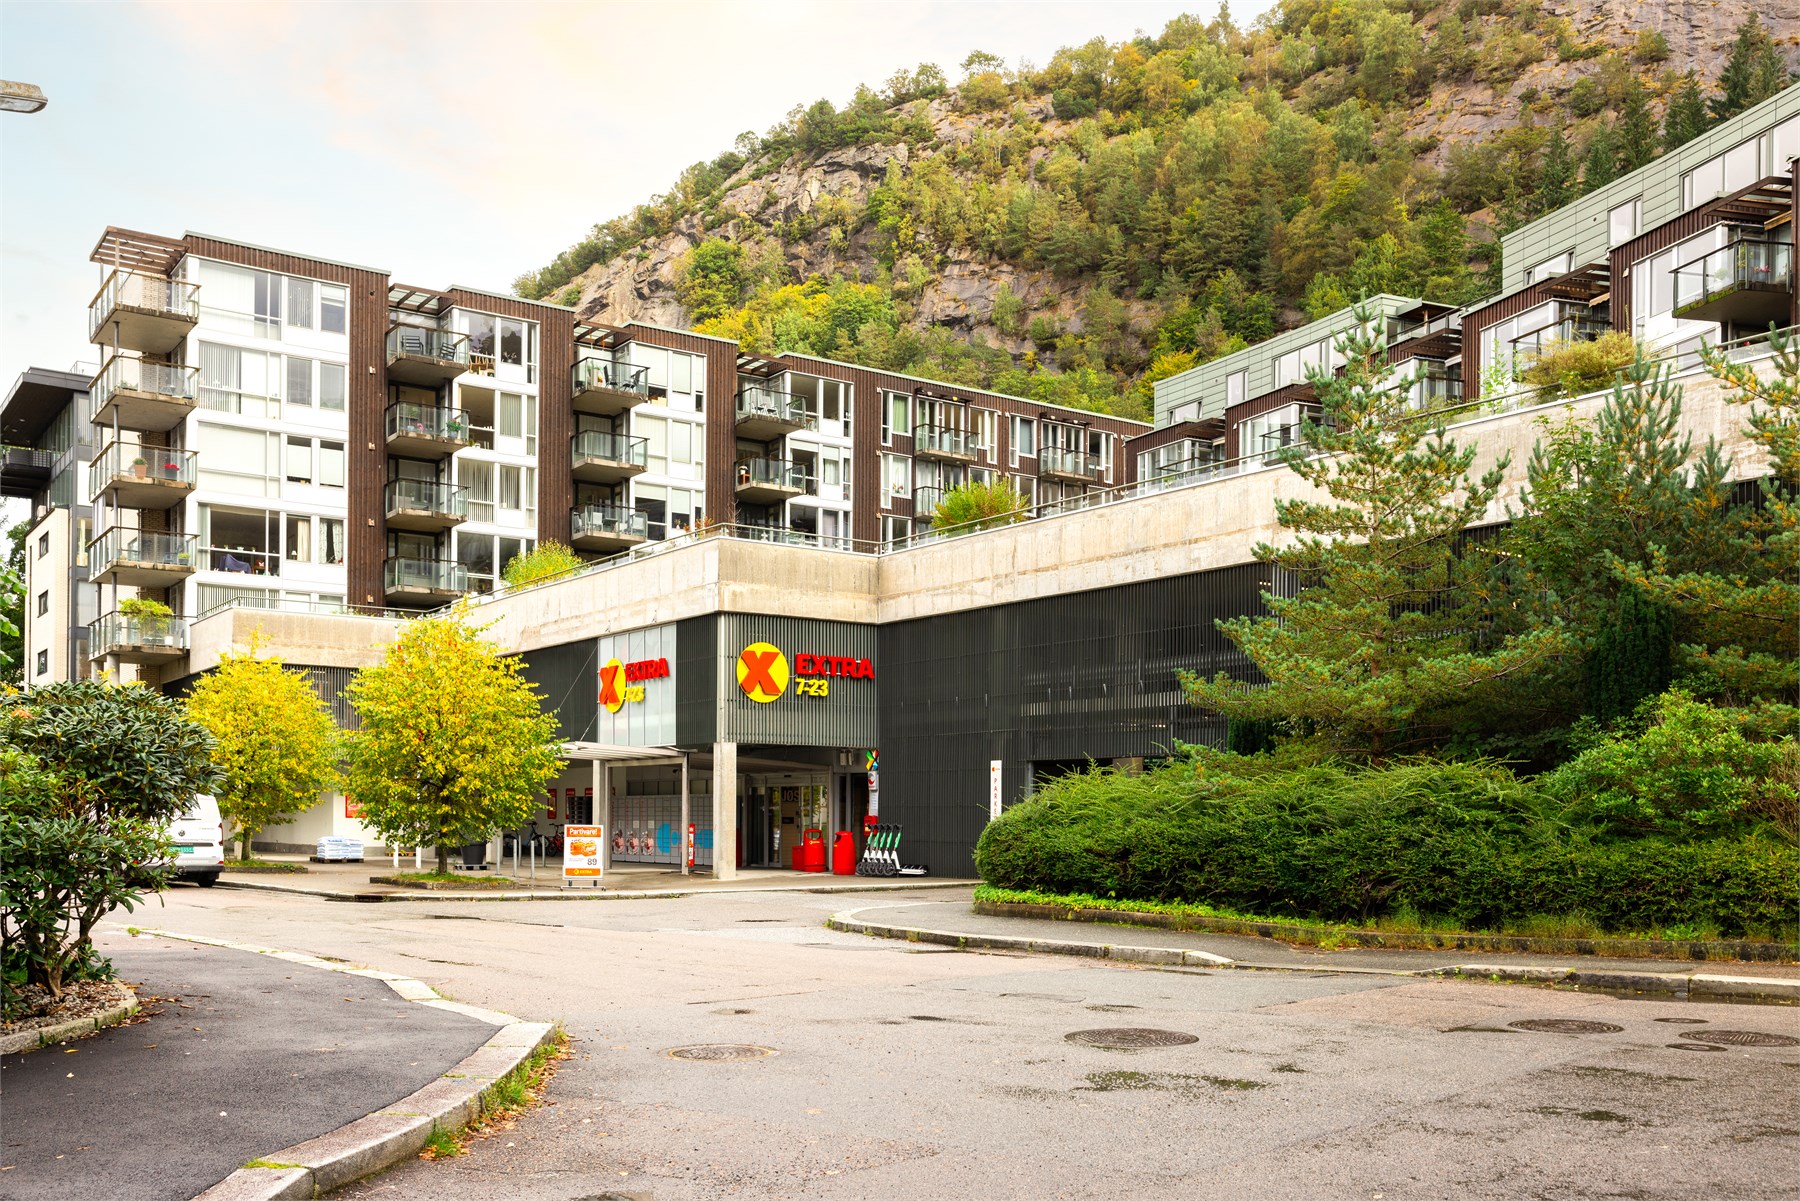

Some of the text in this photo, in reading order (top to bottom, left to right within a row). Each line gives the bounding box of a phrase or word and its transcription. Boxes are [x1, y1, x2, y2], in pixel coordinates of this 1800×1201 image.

[625, 657, 670, 682] EXTRA
[795, 653, 875, 679] EXTRA
[795, 678, 828, 697] 7-23
[569, 827, 598, 835] Partivare!
[587, 857, 598, 866] 89
